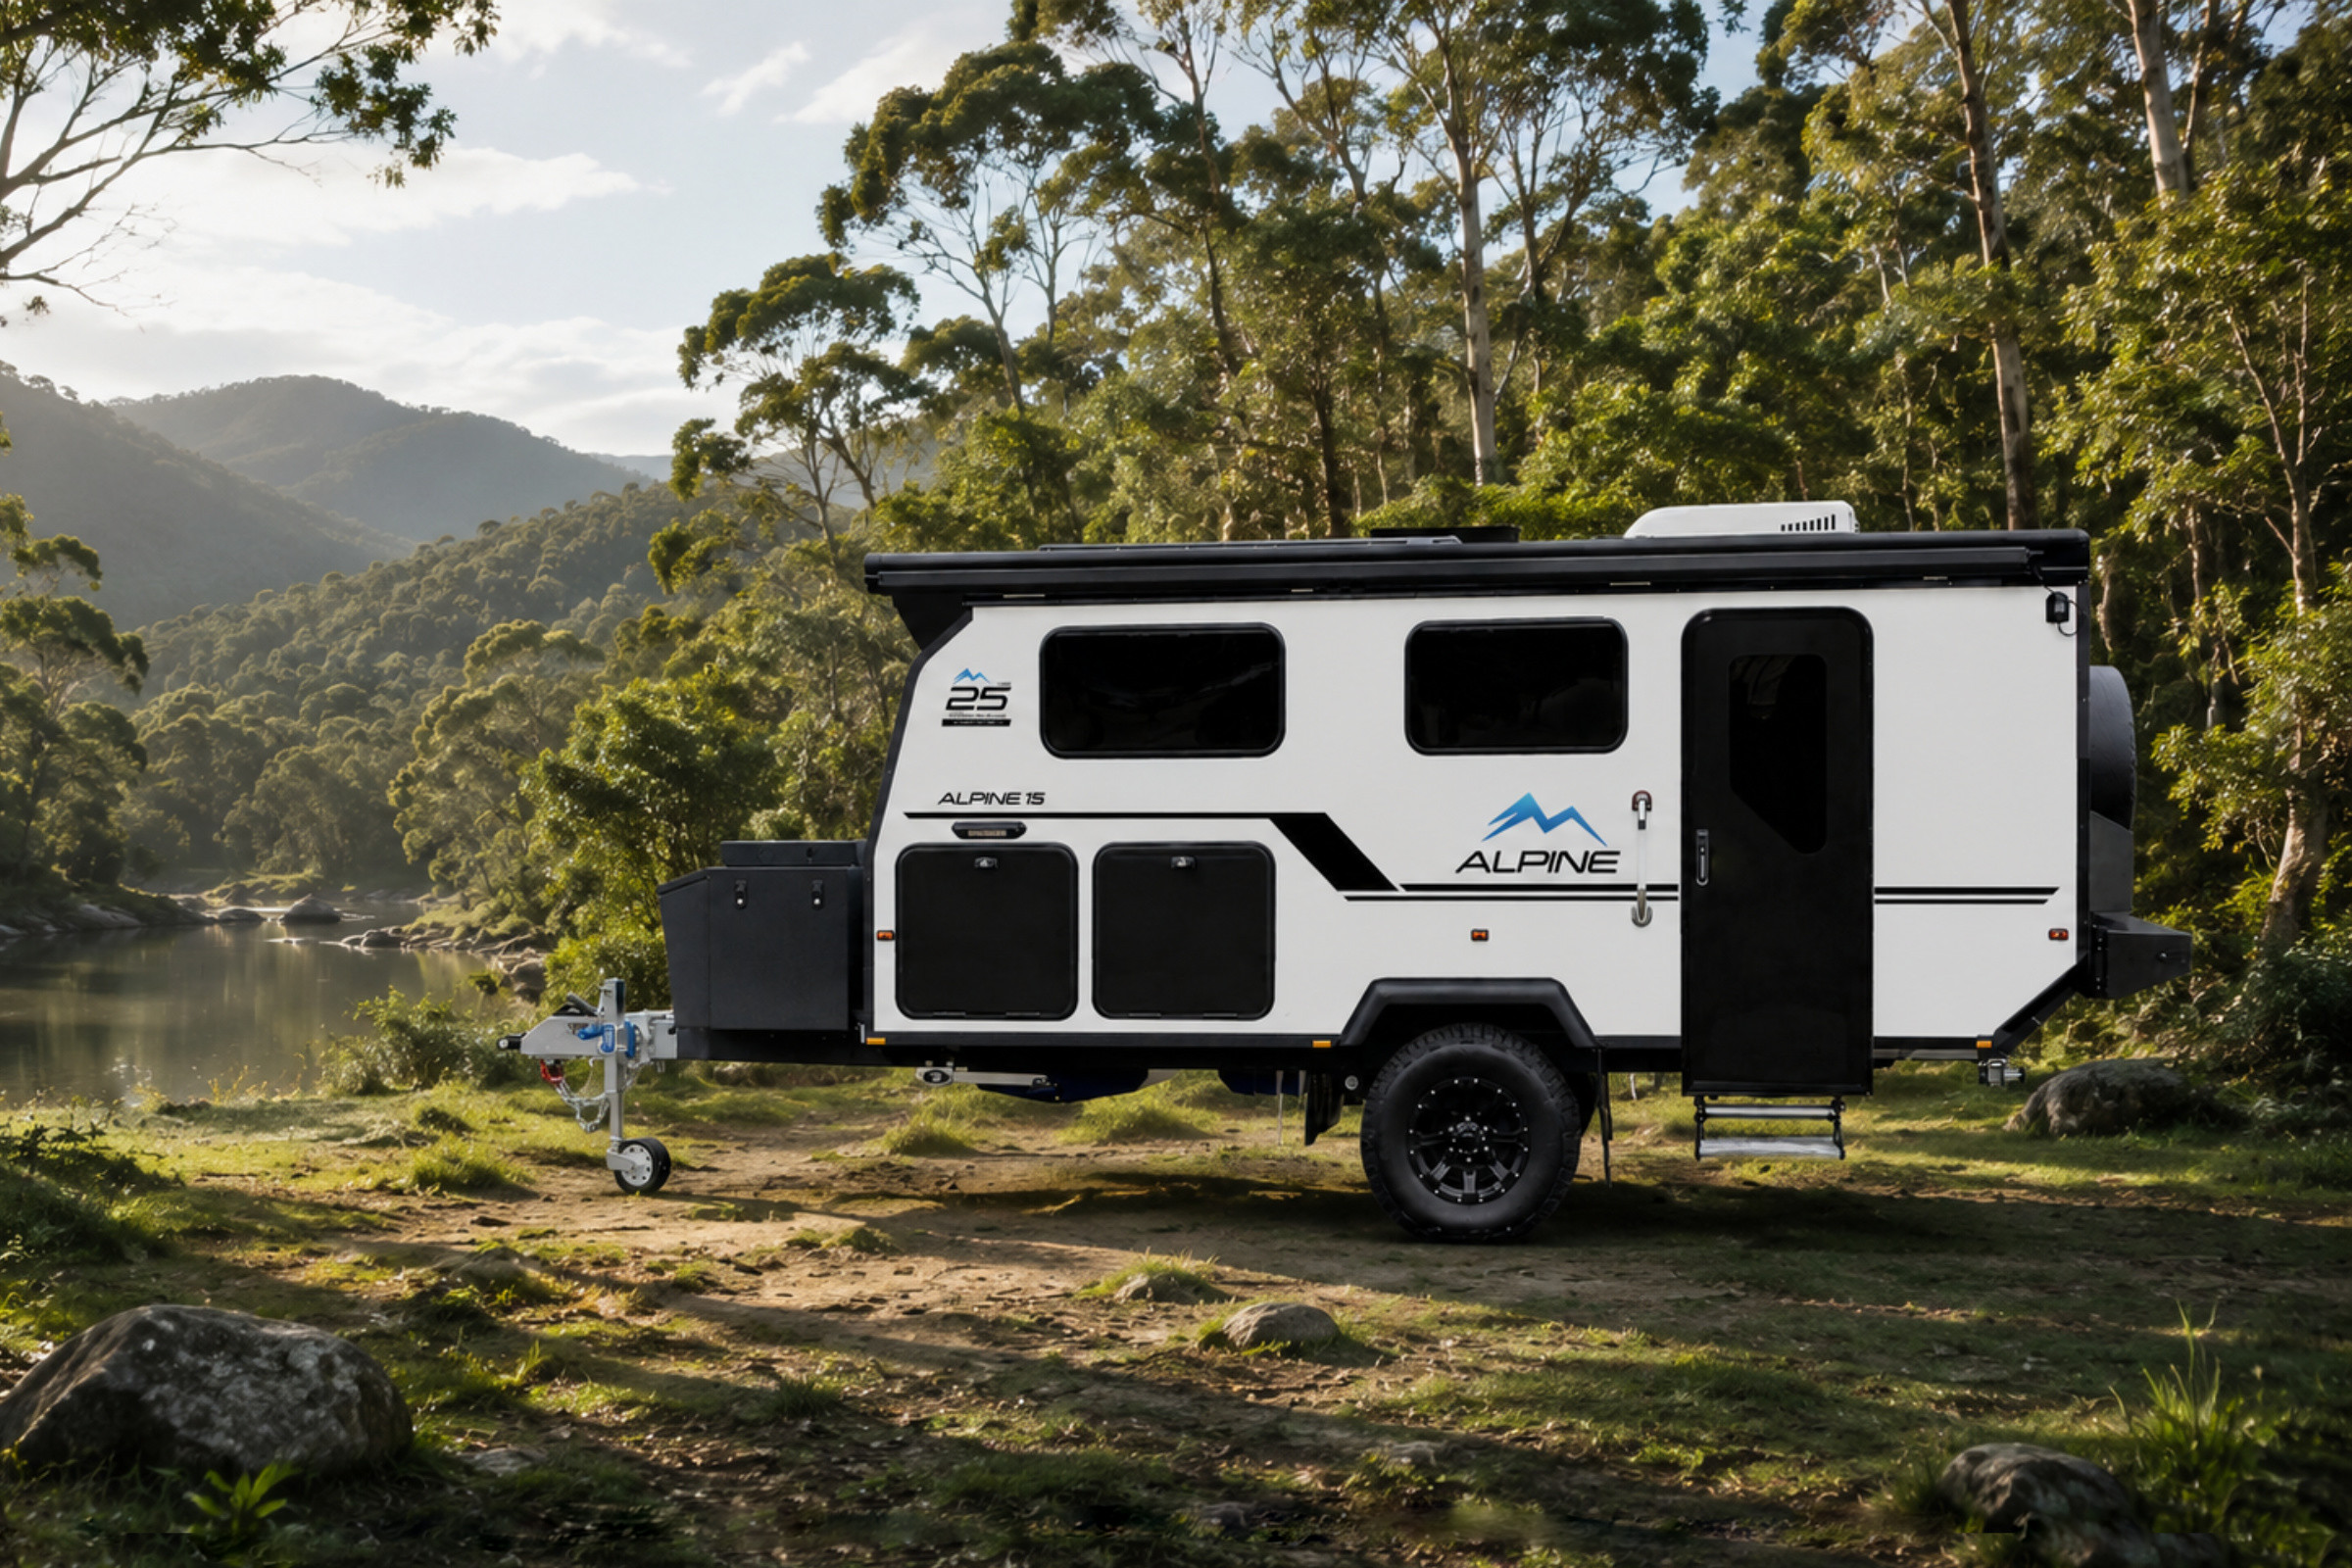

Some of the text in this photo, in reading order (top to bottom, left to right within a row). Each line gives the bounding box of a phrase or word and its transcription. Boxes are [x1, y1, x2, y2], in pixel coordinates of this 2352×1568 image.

[946, 686, 1012, 710] 25
[938, 792, 1047, 806] ALPINE 15
[1455, 850, 1621, 874] ALPINE
